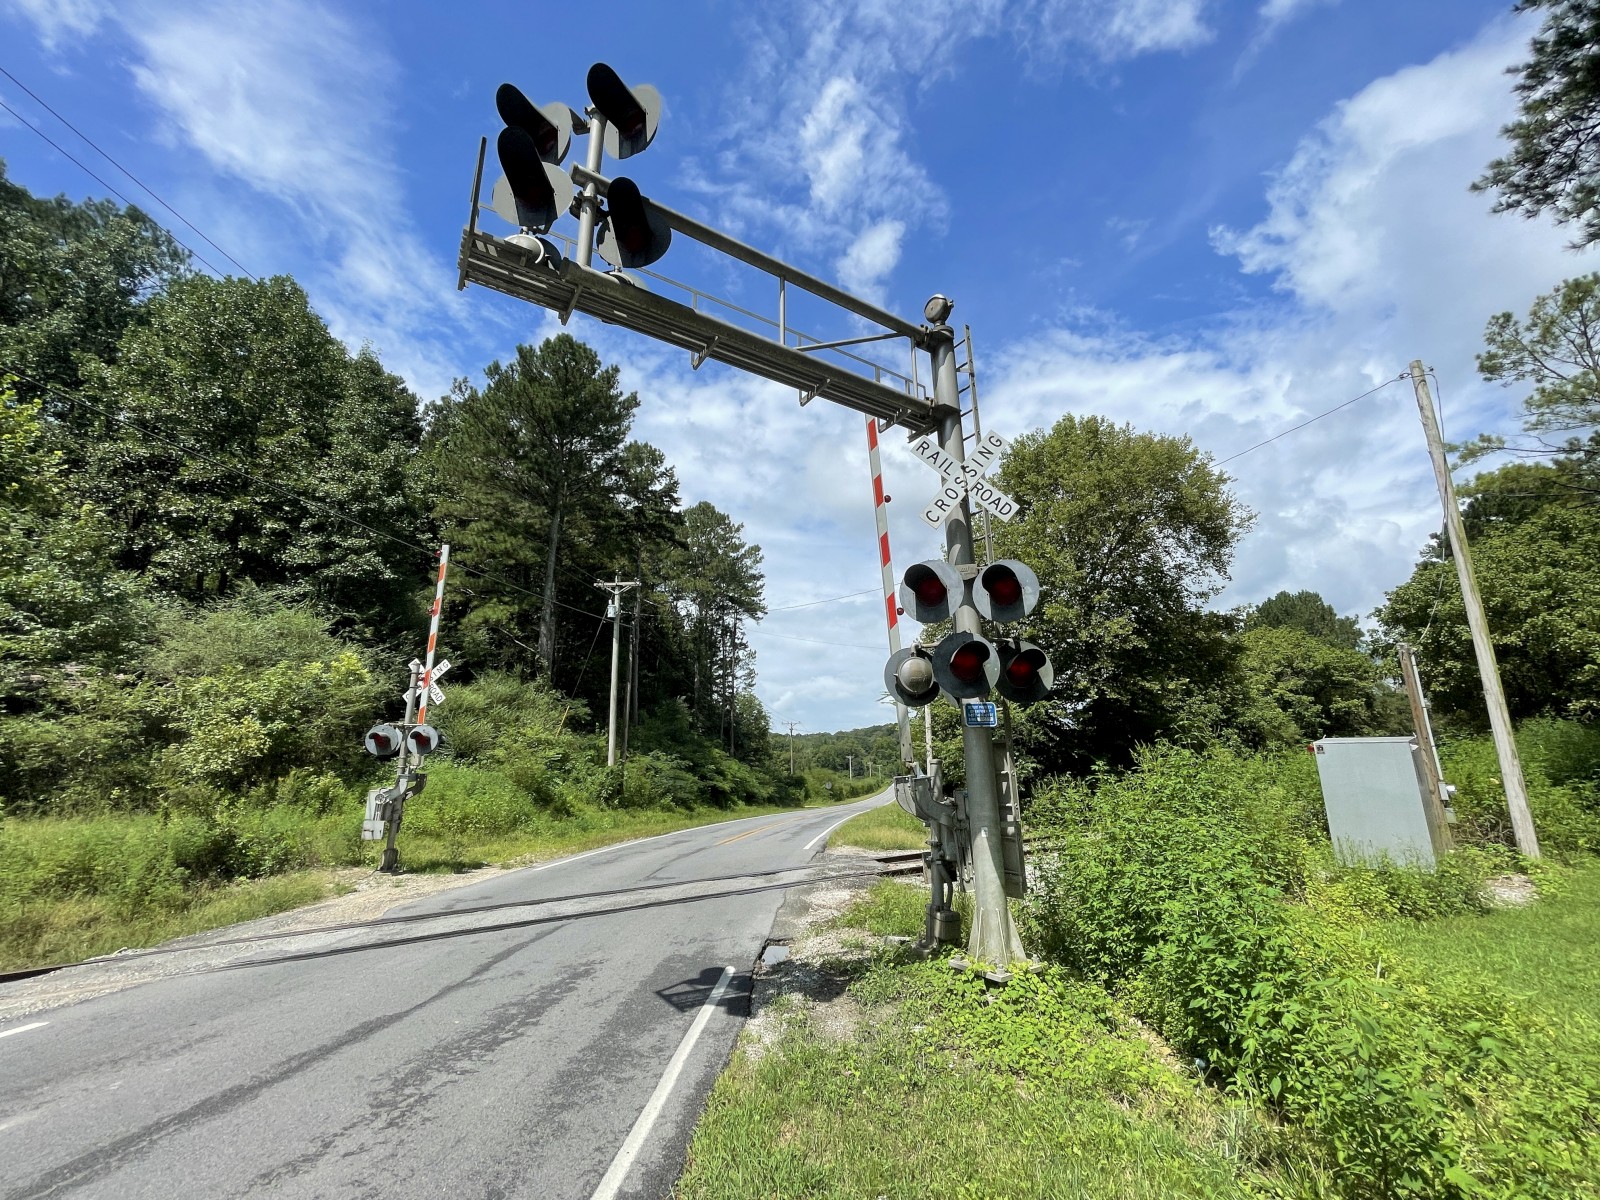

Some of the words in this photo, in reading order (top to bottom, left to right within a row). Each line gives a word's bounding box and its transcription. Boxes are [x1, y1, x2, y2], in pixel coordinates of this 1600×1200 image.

[915, 440, 954, 477] RAIL
[925, 435, 1003, 523] CROSSING
[970, 481, 1013, 516] ROAD
